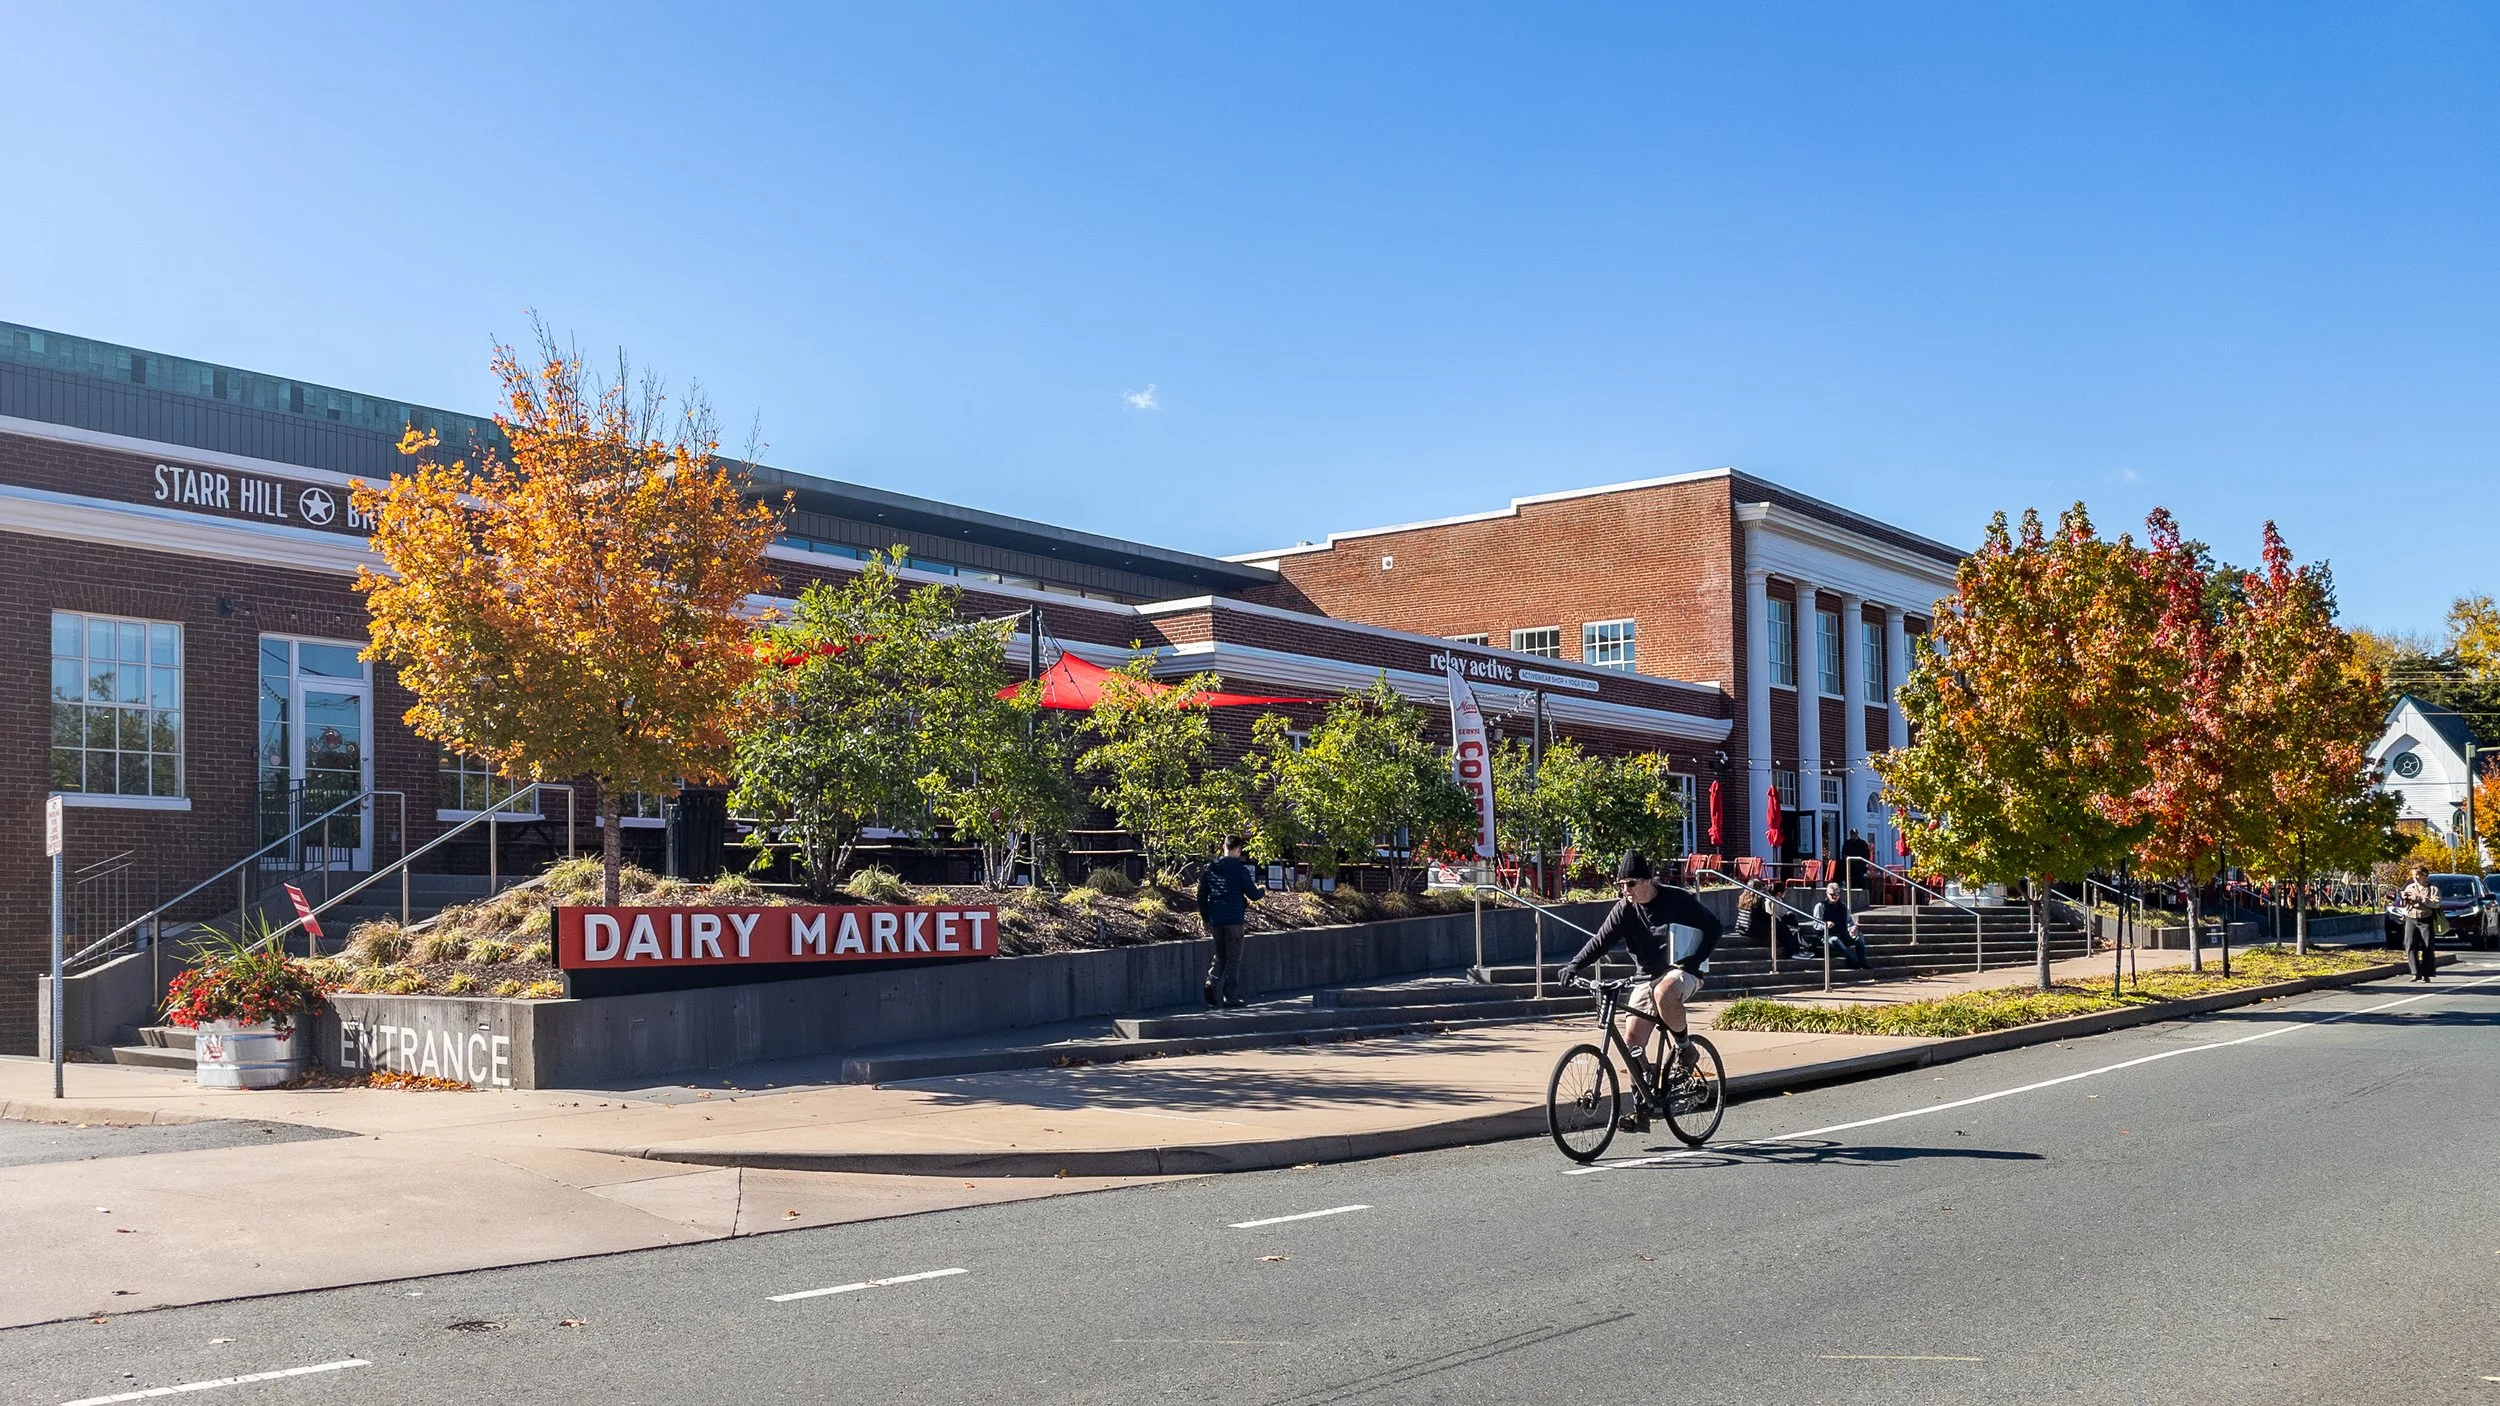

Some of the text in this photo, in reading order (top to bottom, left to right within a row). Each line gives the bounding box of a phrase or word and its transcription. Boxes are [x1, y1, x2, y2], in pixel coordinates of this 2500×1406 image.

[154, 464, 288, 518] STARR HILL
[1430, 650, 1513, 681] relay active
[1521, 671, 1597, 690] ACTIVEWEAR SHOP YOGA STUDIO
[584, 911, 990, 961] DAIRY MARKET
[340, 1021, 510, 1087] ENTRANCE
